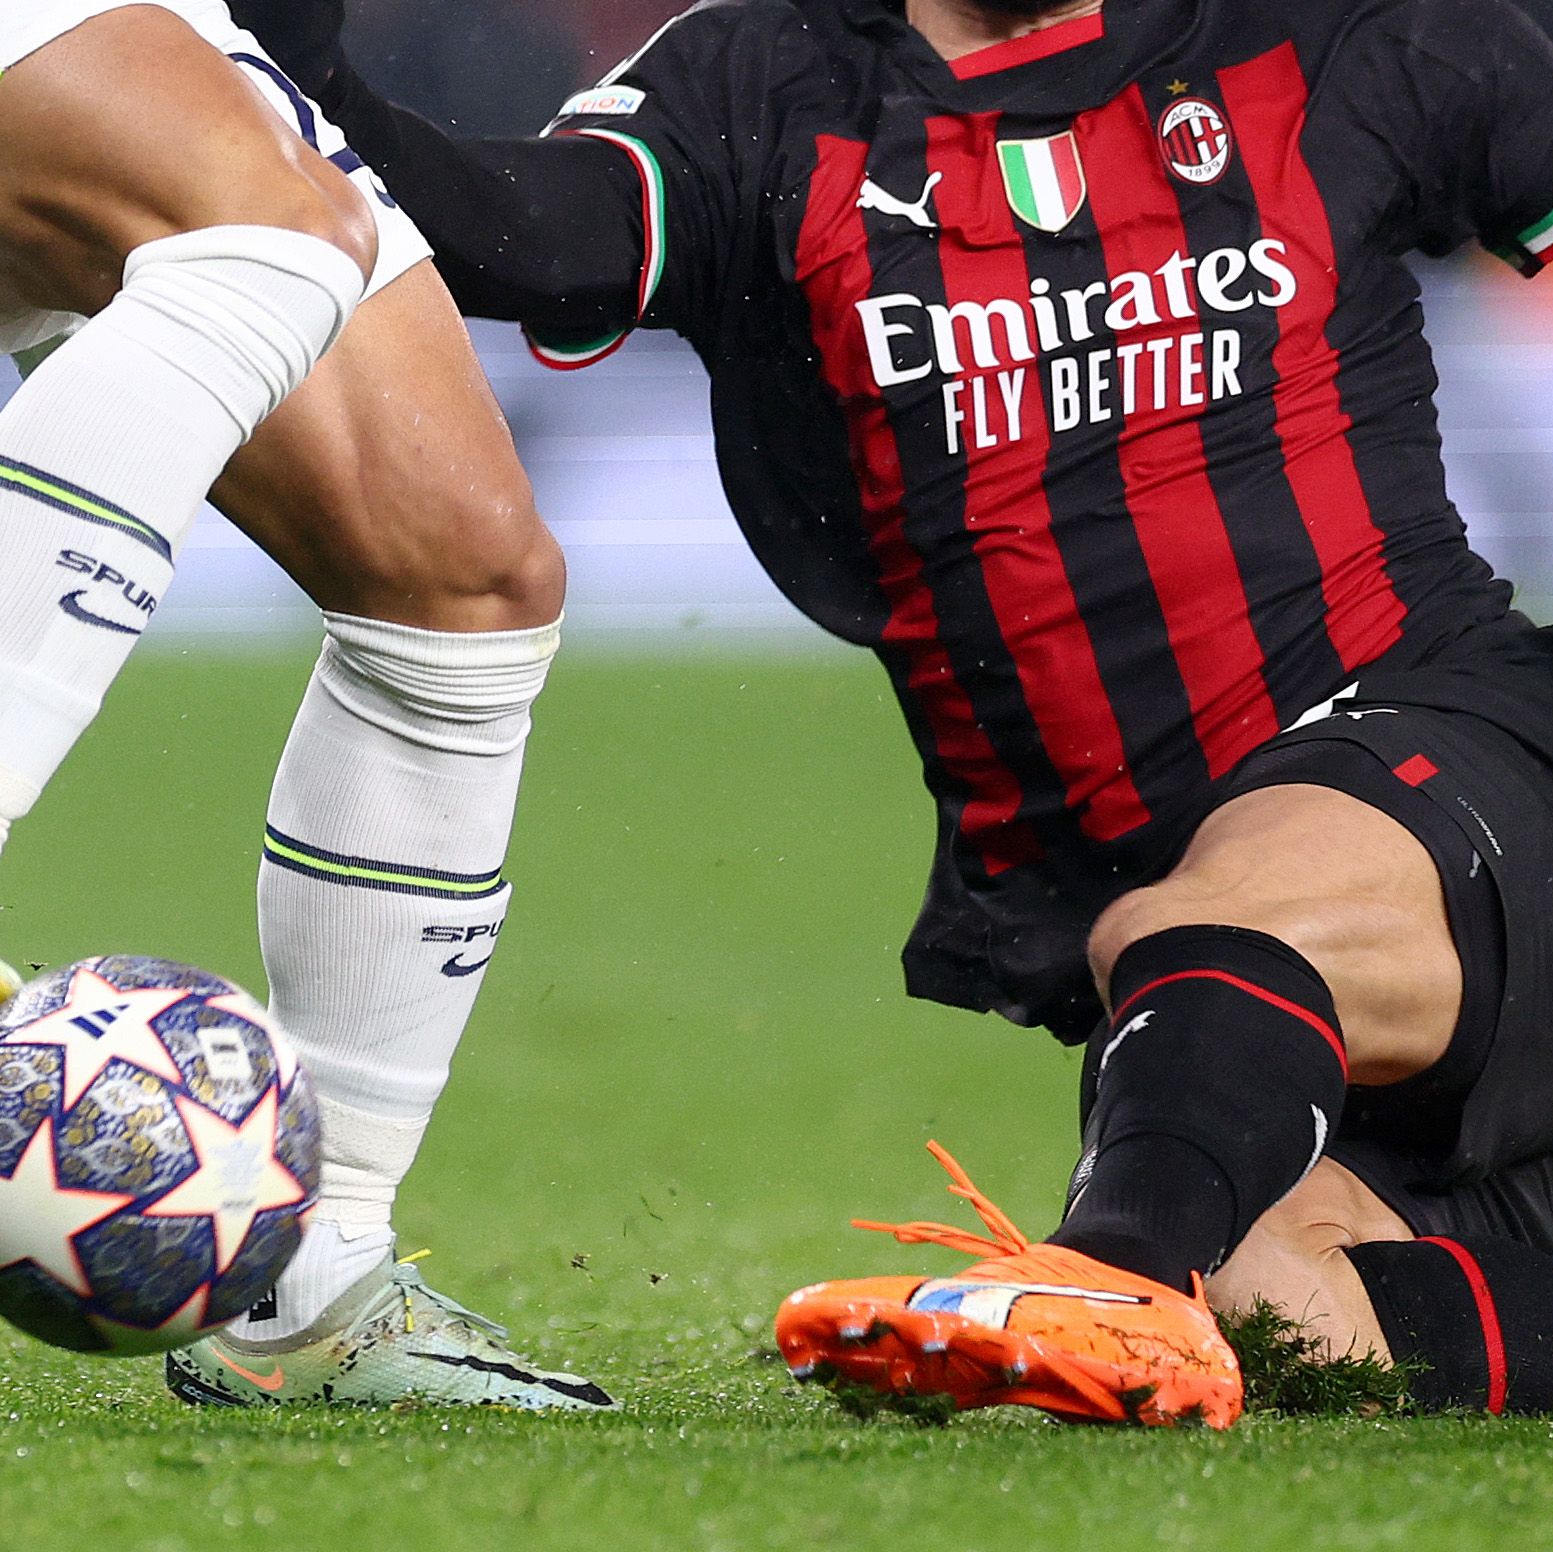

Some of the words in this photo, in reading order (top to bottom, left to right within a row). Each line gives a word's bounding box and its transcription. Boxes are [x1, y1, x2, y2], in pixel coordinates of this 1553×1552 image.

[1170, 105, 1208, 126] ACM
[1189, 160, 1220, 176] 1899
[855, 239, 1297, 387] Emirates
[942, 367, 1025, 455] FLY
[1051, 329, 1242, 432] BETTER
